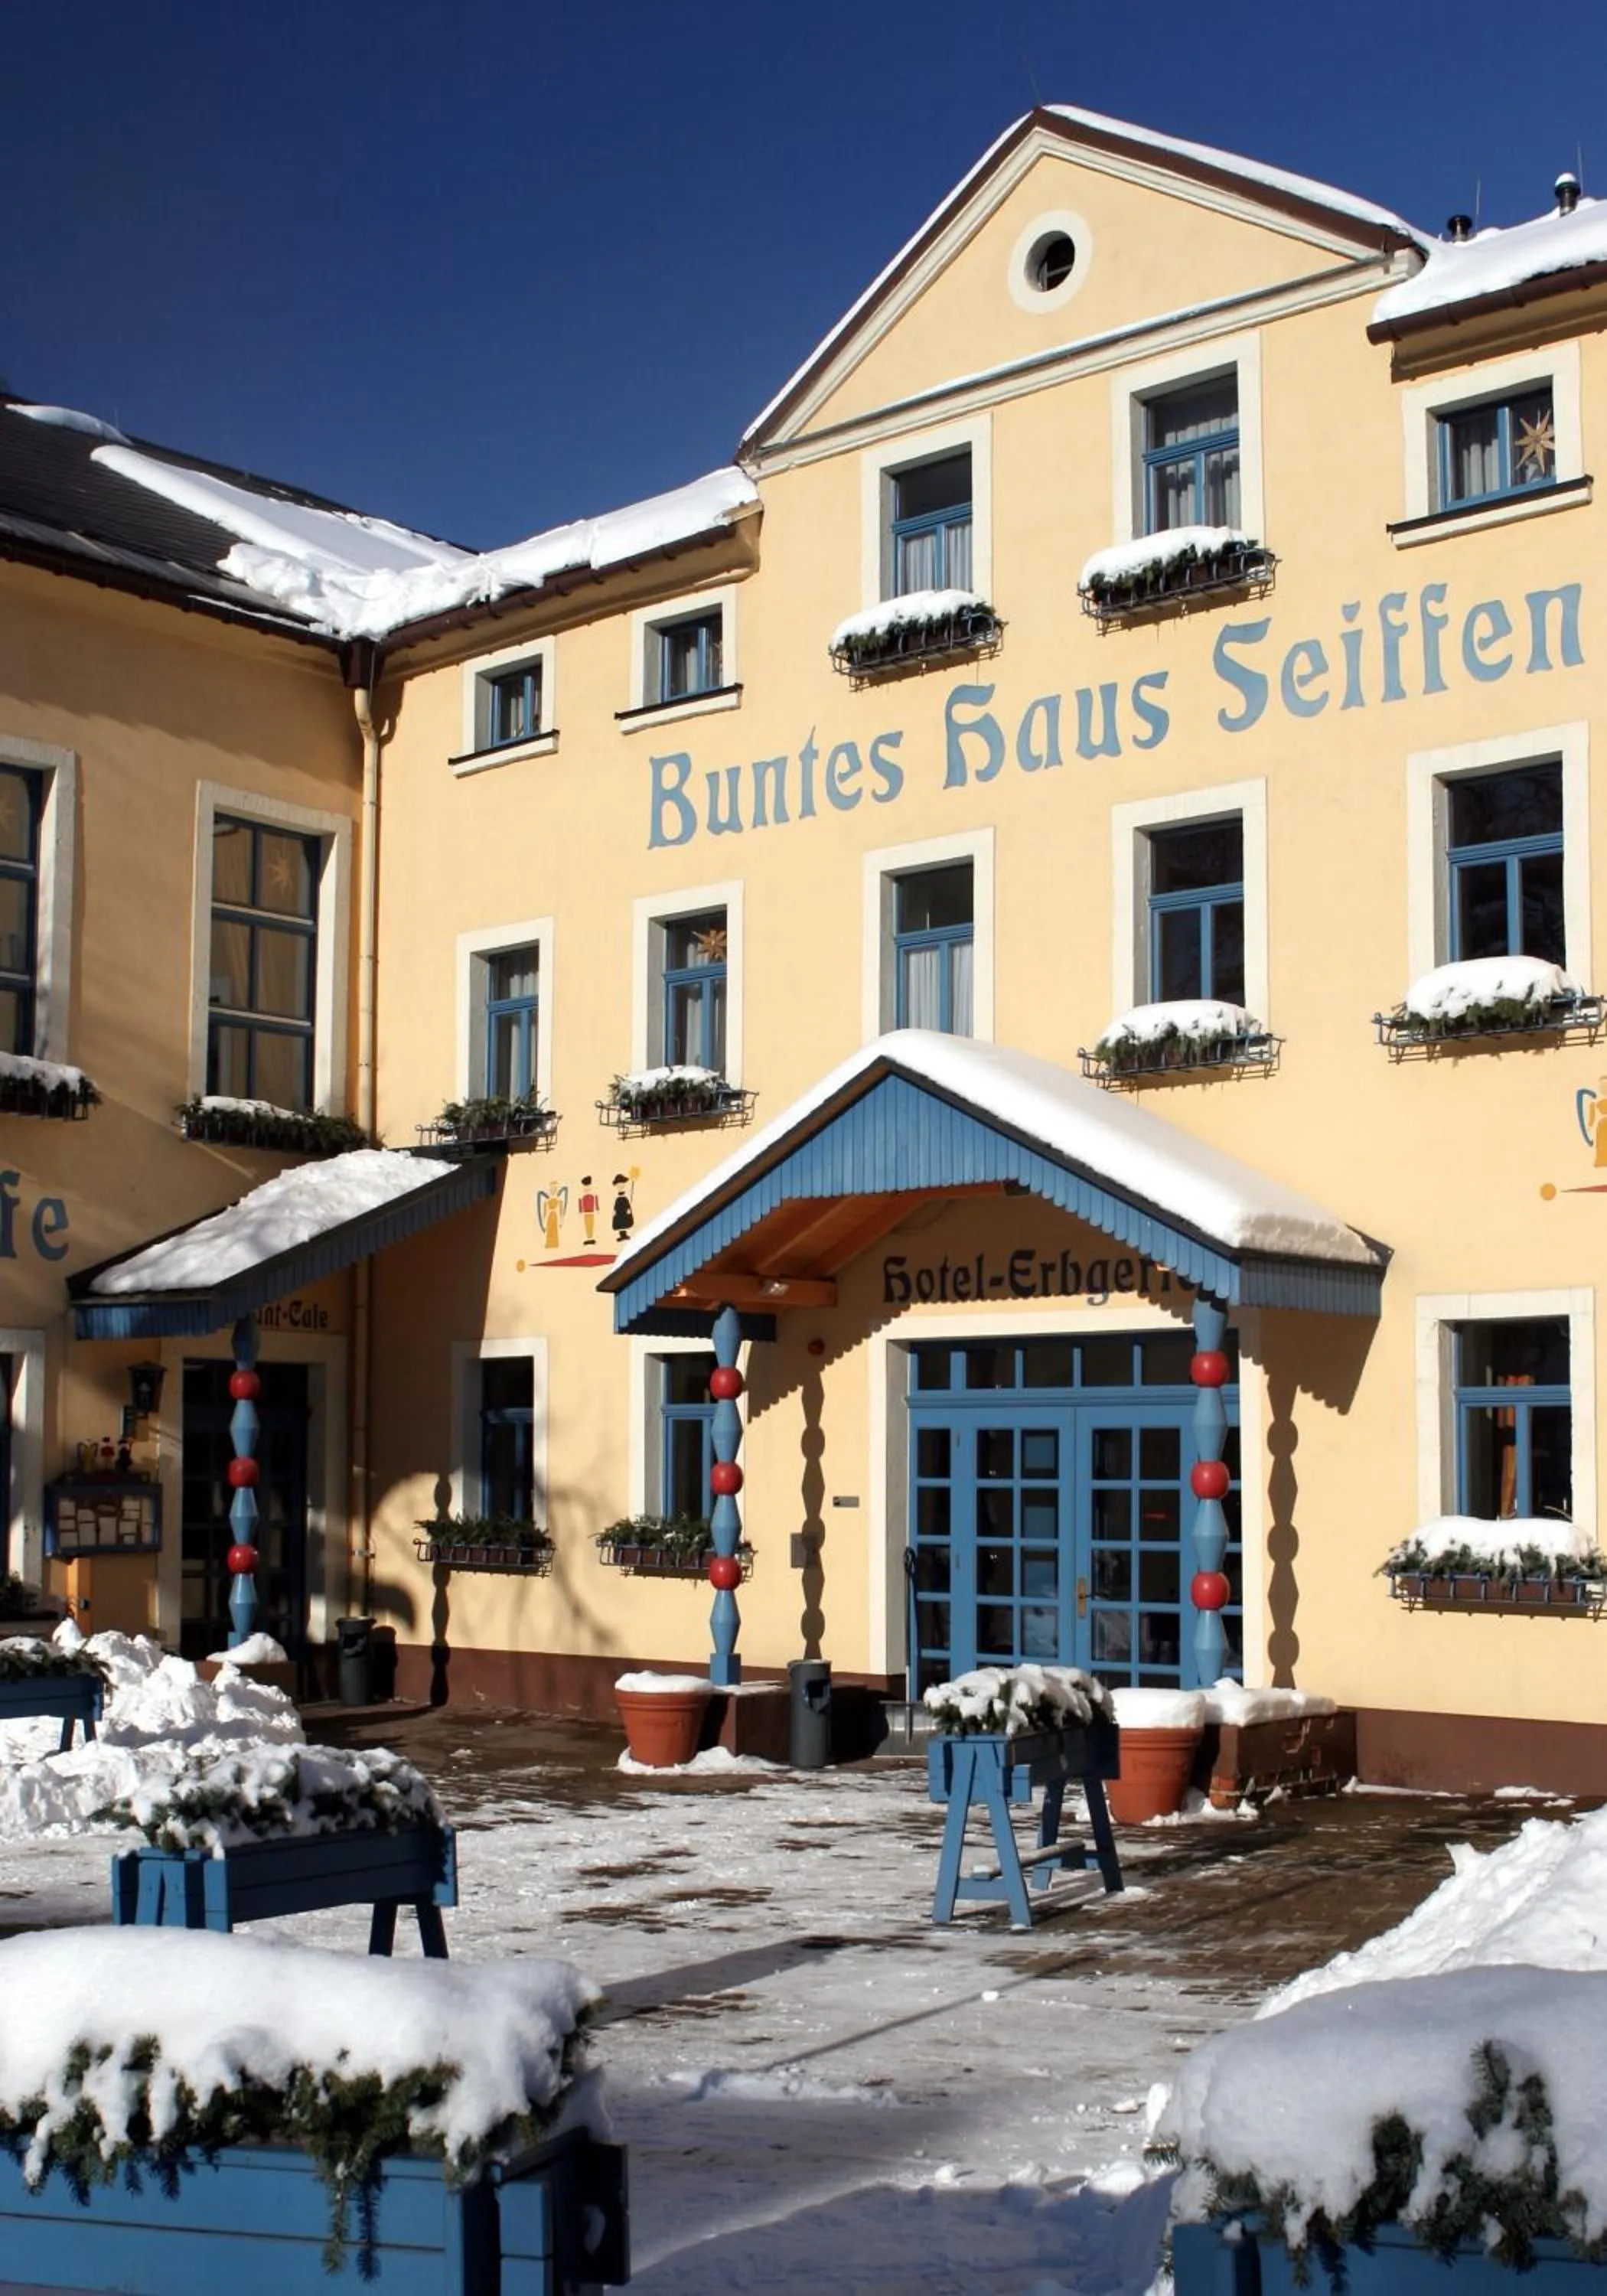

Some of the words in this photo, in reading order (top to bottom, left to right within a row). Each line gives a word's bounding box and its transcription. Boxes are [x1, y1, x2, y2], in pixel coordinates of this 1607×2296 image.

[648, 727, 905, 850] Buntes
[944, 670, 1170, 789] Haus
[1212, 582, 1585, 732] Seiffen
